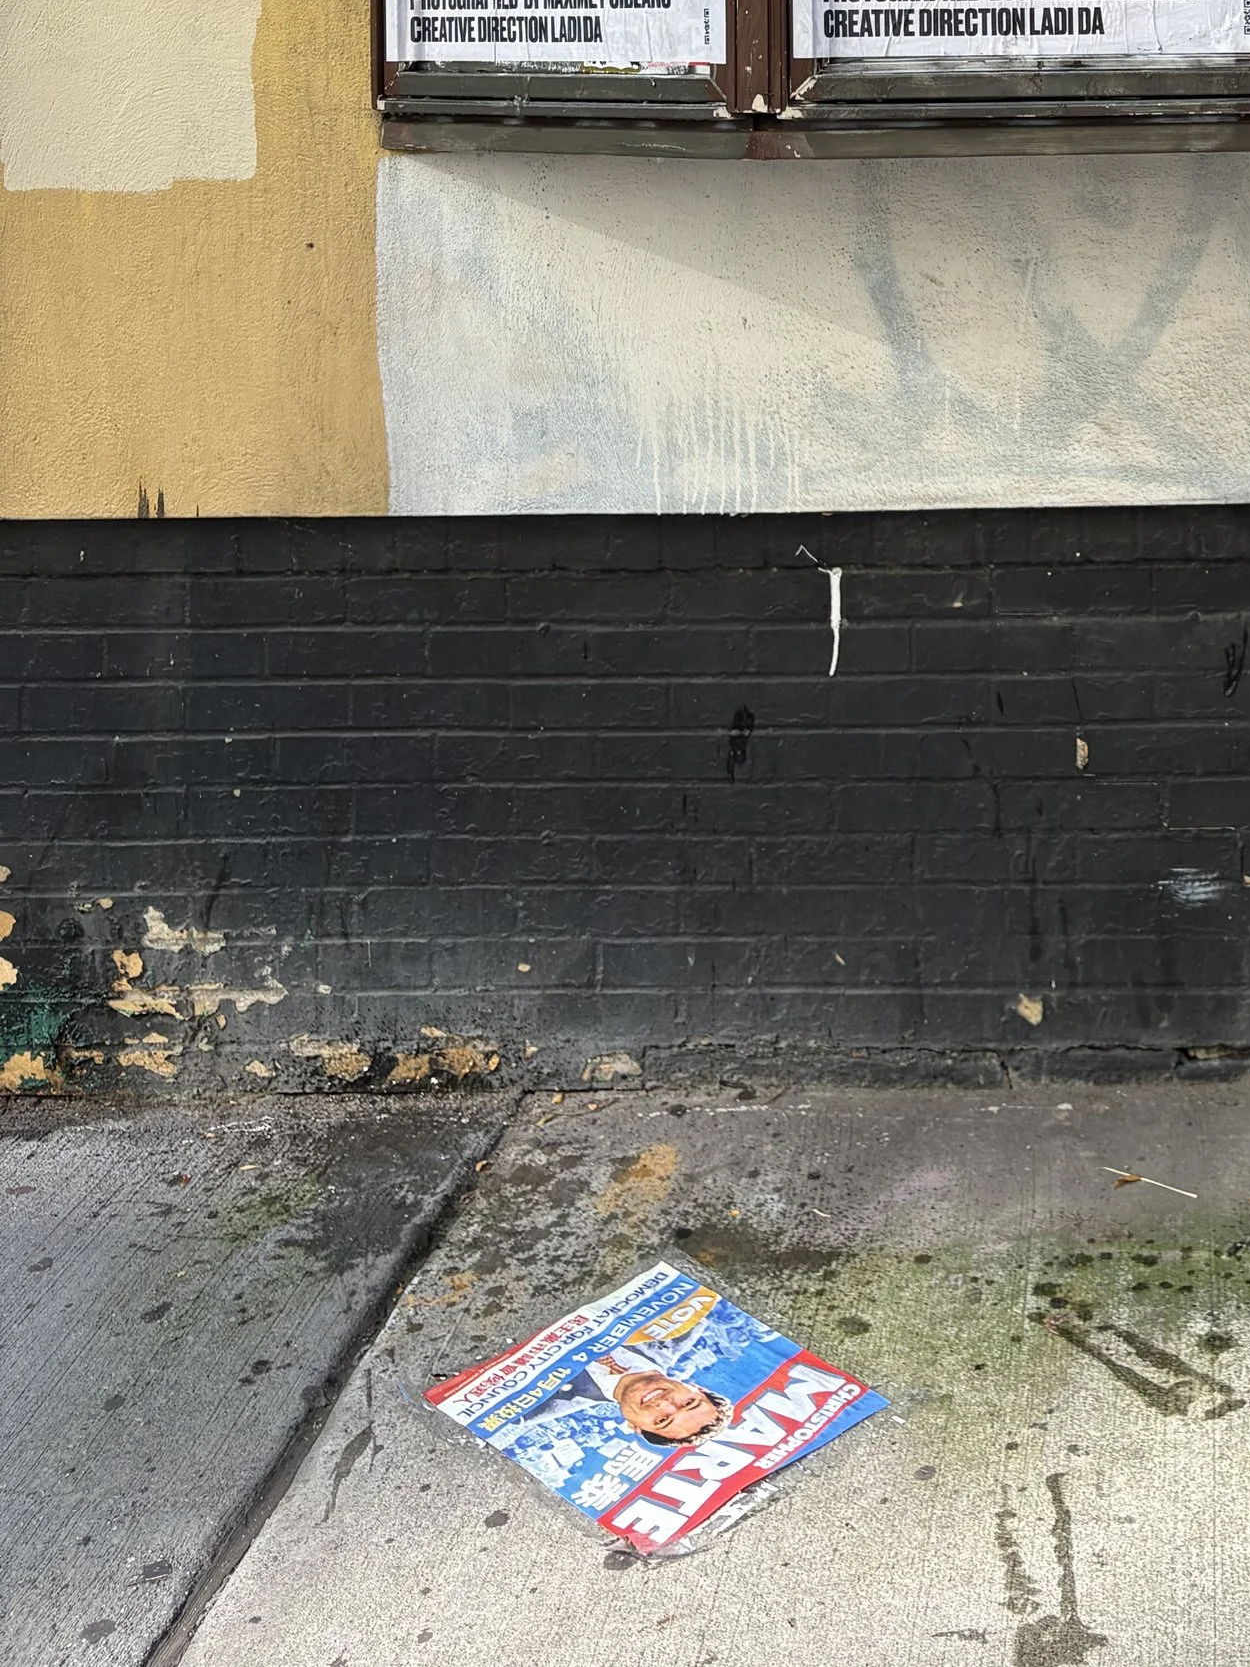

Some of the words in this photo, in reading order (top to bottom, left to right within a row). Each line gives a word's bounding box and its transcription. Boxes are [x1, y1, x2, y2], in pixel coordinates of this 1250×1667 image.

[410, 16, 475, 43] CREATIVE
[478, 16, 548, 43] DIRECTION
[551, 16, 582, 43] LADI
[584, 16, 603, 42] DA
[823, 9, 915, 39] CREATIVE
[919, 8, 1026, 38] DIRECTION
[1029, 7, 1075, 36] LADI
[1078, 7, 1105, 36] DA
[562, 1326, 594, 1345] FOR
[591, 1281, 695, 1353] NOVEMBER
[644, 1294, 715, 1340] VOTE
[530, 1345, 561, 1371] CITY
[572, 1352, 588, 1364] 4
[456, 1368, 528, 1421] COUNCIL
[753, 1383, 862, 1470] CHRISTOPHER
[572, 1440, 666, 1511] 馬泰
[612, 1359, 851, 1546] MARTE
